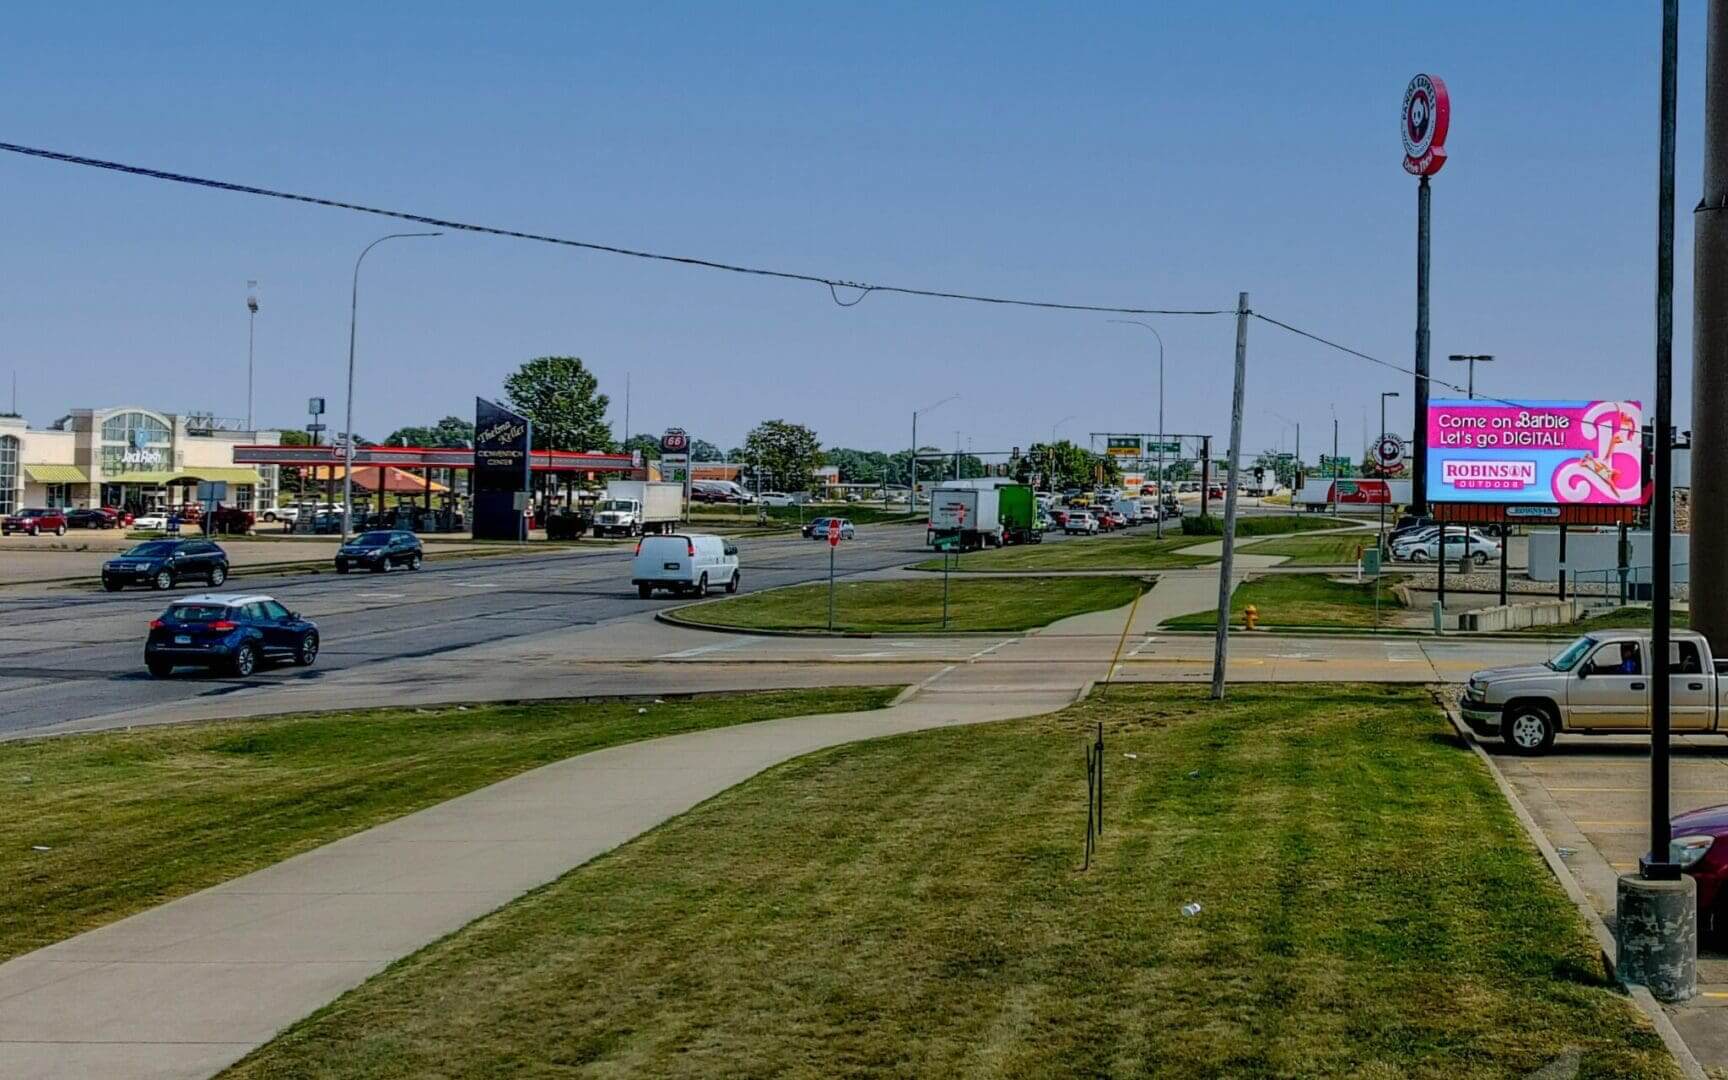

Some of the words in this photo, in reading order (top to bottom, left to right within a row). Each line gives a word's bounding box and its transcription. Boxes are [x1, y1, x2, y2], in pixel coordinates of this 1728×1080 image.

[1438, 414, 1487, 428] Come
[1491, 417, 1512, 428] on
[1515, 411, 1570, 428] Barbie
[667, 437, 681, 446] 66
[1440, 431, 1472, 444] Let's
[1476, 434, 1498, 447] go
[1503, 431, 1565, 445] DIGITAL!
[1447, 464, 1532, 477] ROBINSON
[1459, 480, 1519, 488] OUTDOOR
